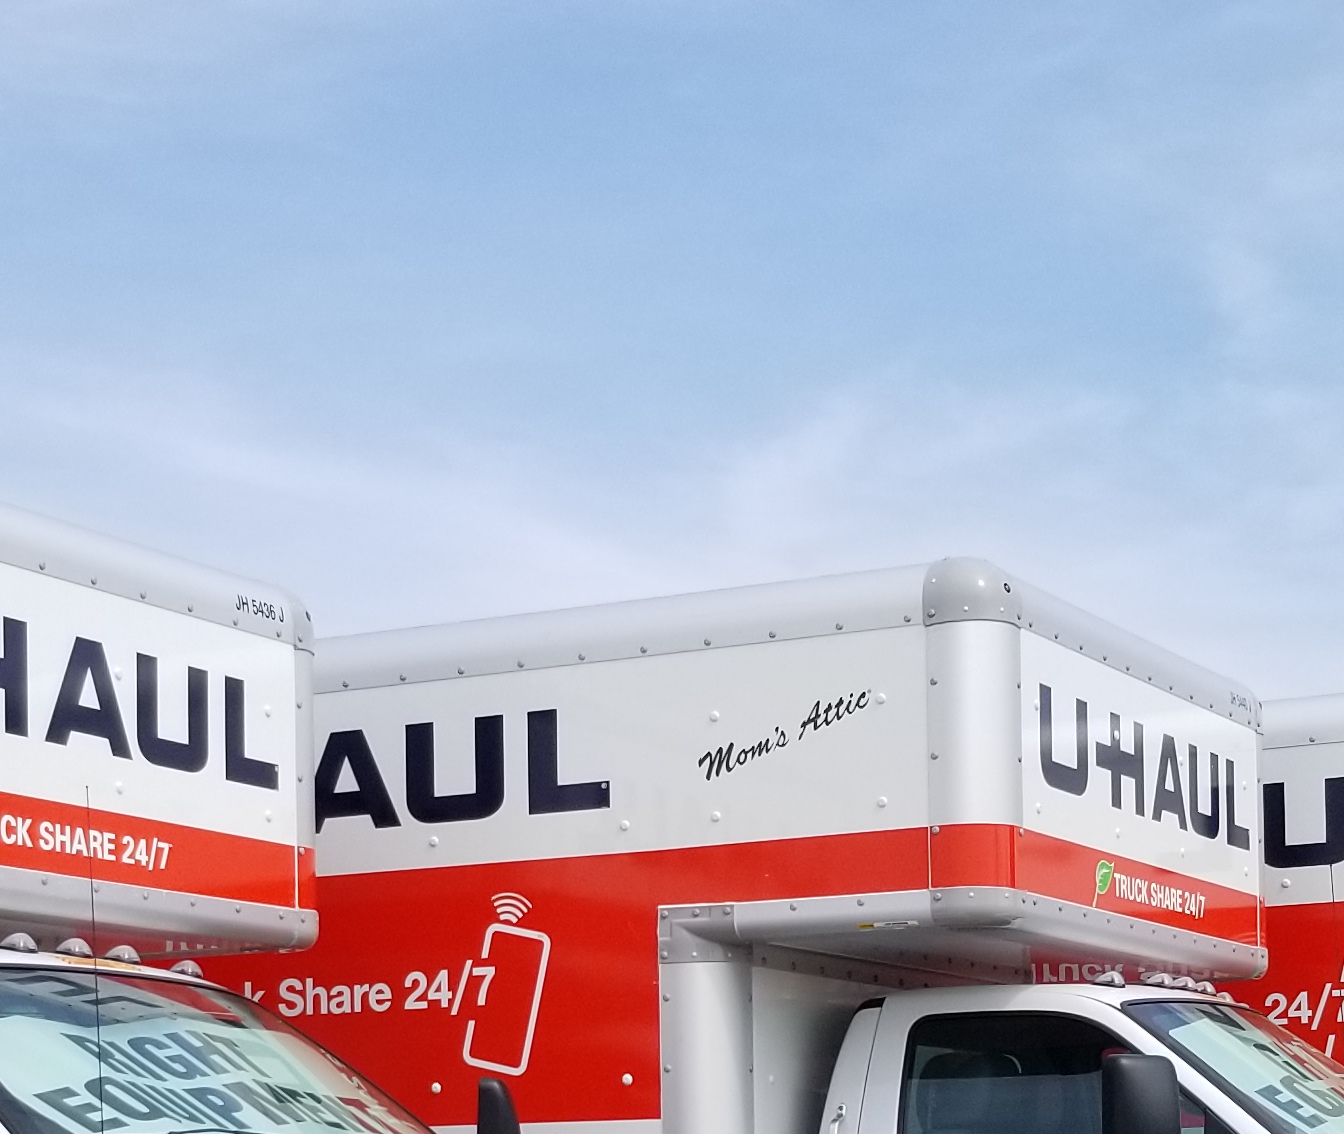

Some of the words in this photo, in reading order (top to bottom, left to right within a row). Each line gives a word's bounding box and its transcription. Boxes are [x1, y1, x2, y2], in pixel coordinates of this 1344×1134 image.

[236, 594, 250, 614] JH
[252, 599, 276, 621] 5436
[279, 606, 285, 623] J
[699, 725, 789, 781] Mom's
[798, 690, 869, 741] Attic
[39, 821, 117, 864] SHARE
[121, 836, 172, 872] 24/7
[1113, 872, 1149, 905] TRUCK
[1150, 882, 1183, 913] SHARE
[1184, 891, 1206, 920] 24/7
[278, 974, 393, 1018] Share
[404, 959, 496, 1017] 24/7
[60, 1030, 273, 1083] RIGHT
